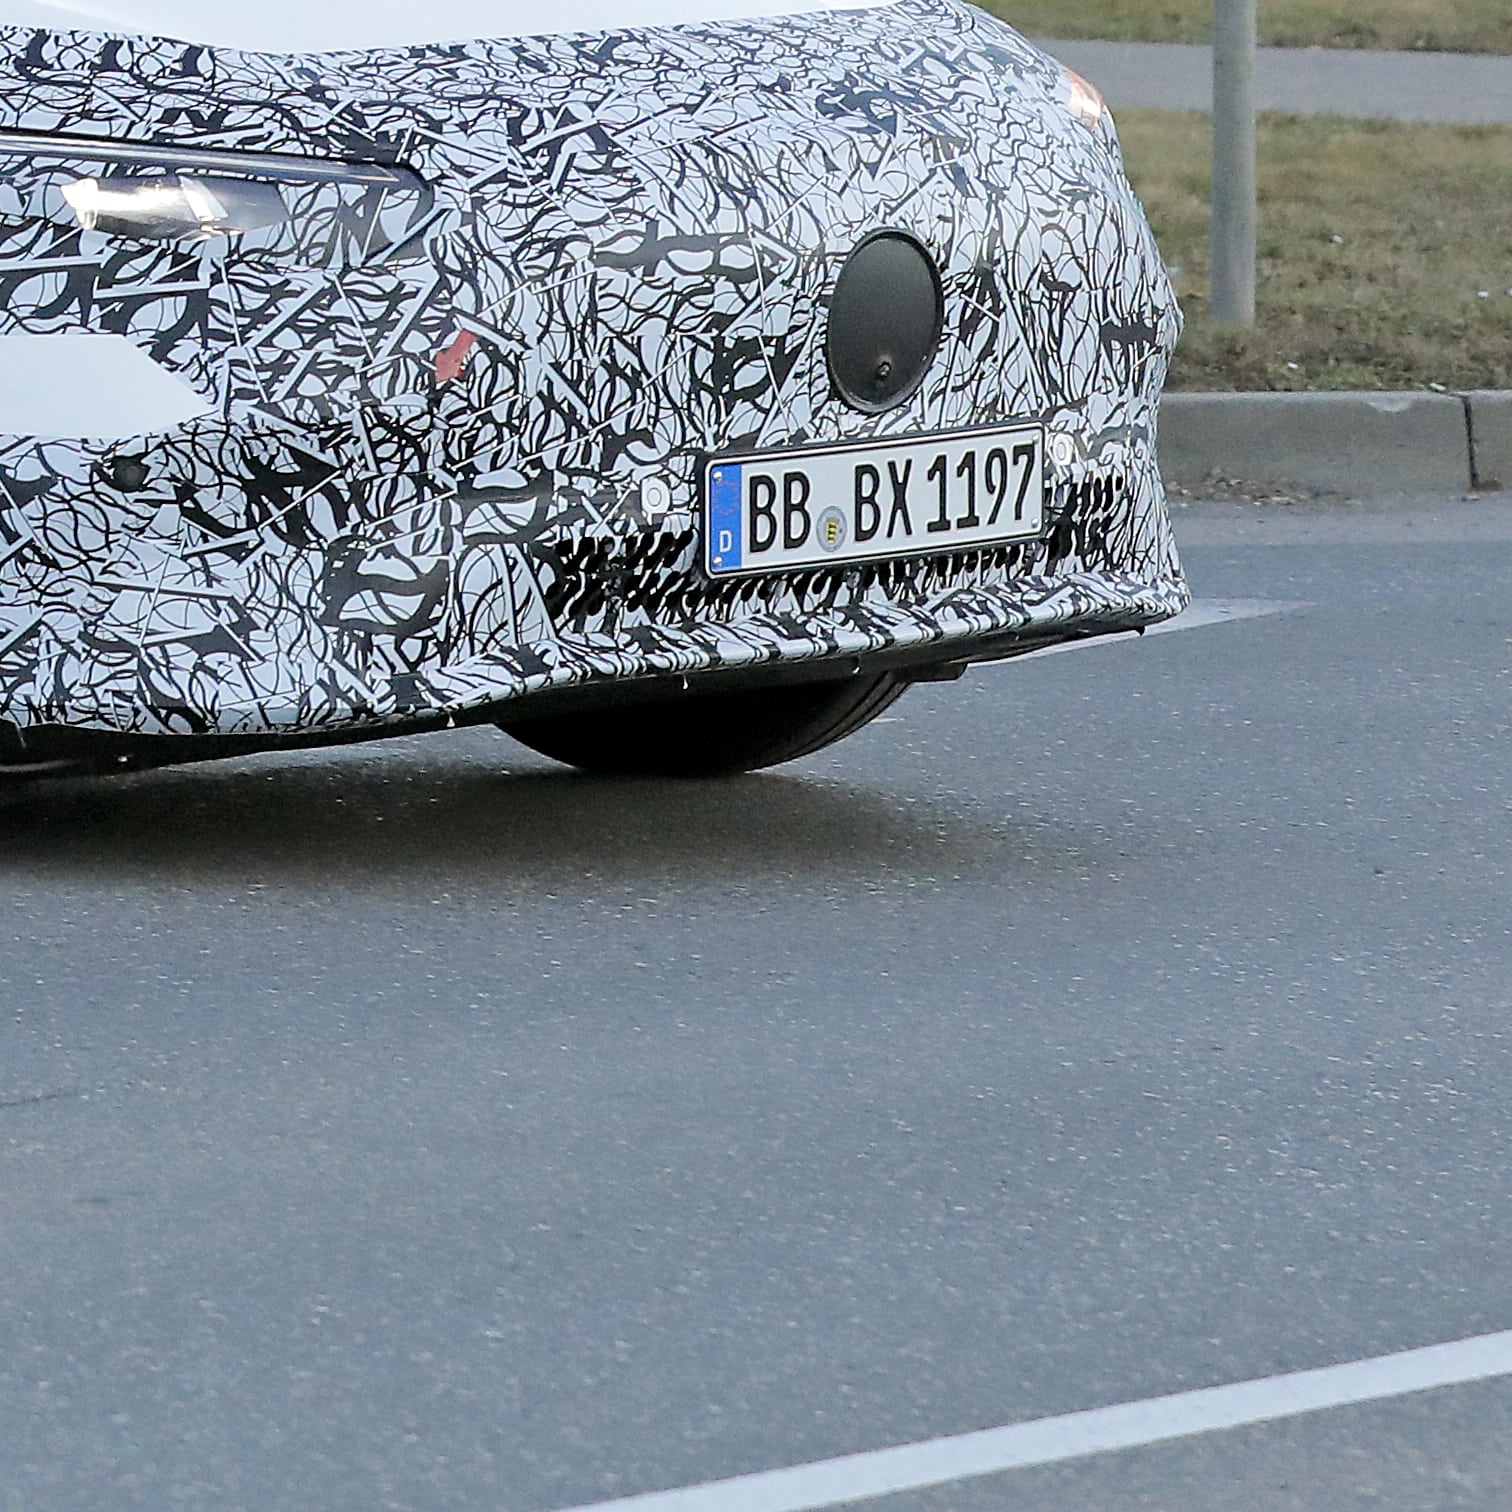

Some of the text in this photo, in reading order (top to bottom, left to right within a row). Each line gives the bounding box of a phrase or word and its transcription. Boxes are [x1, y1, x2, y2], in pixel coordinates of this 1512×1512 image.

[749, 443, 1036, 553] BB BX 1197
[719, 530, 732, 553] D
